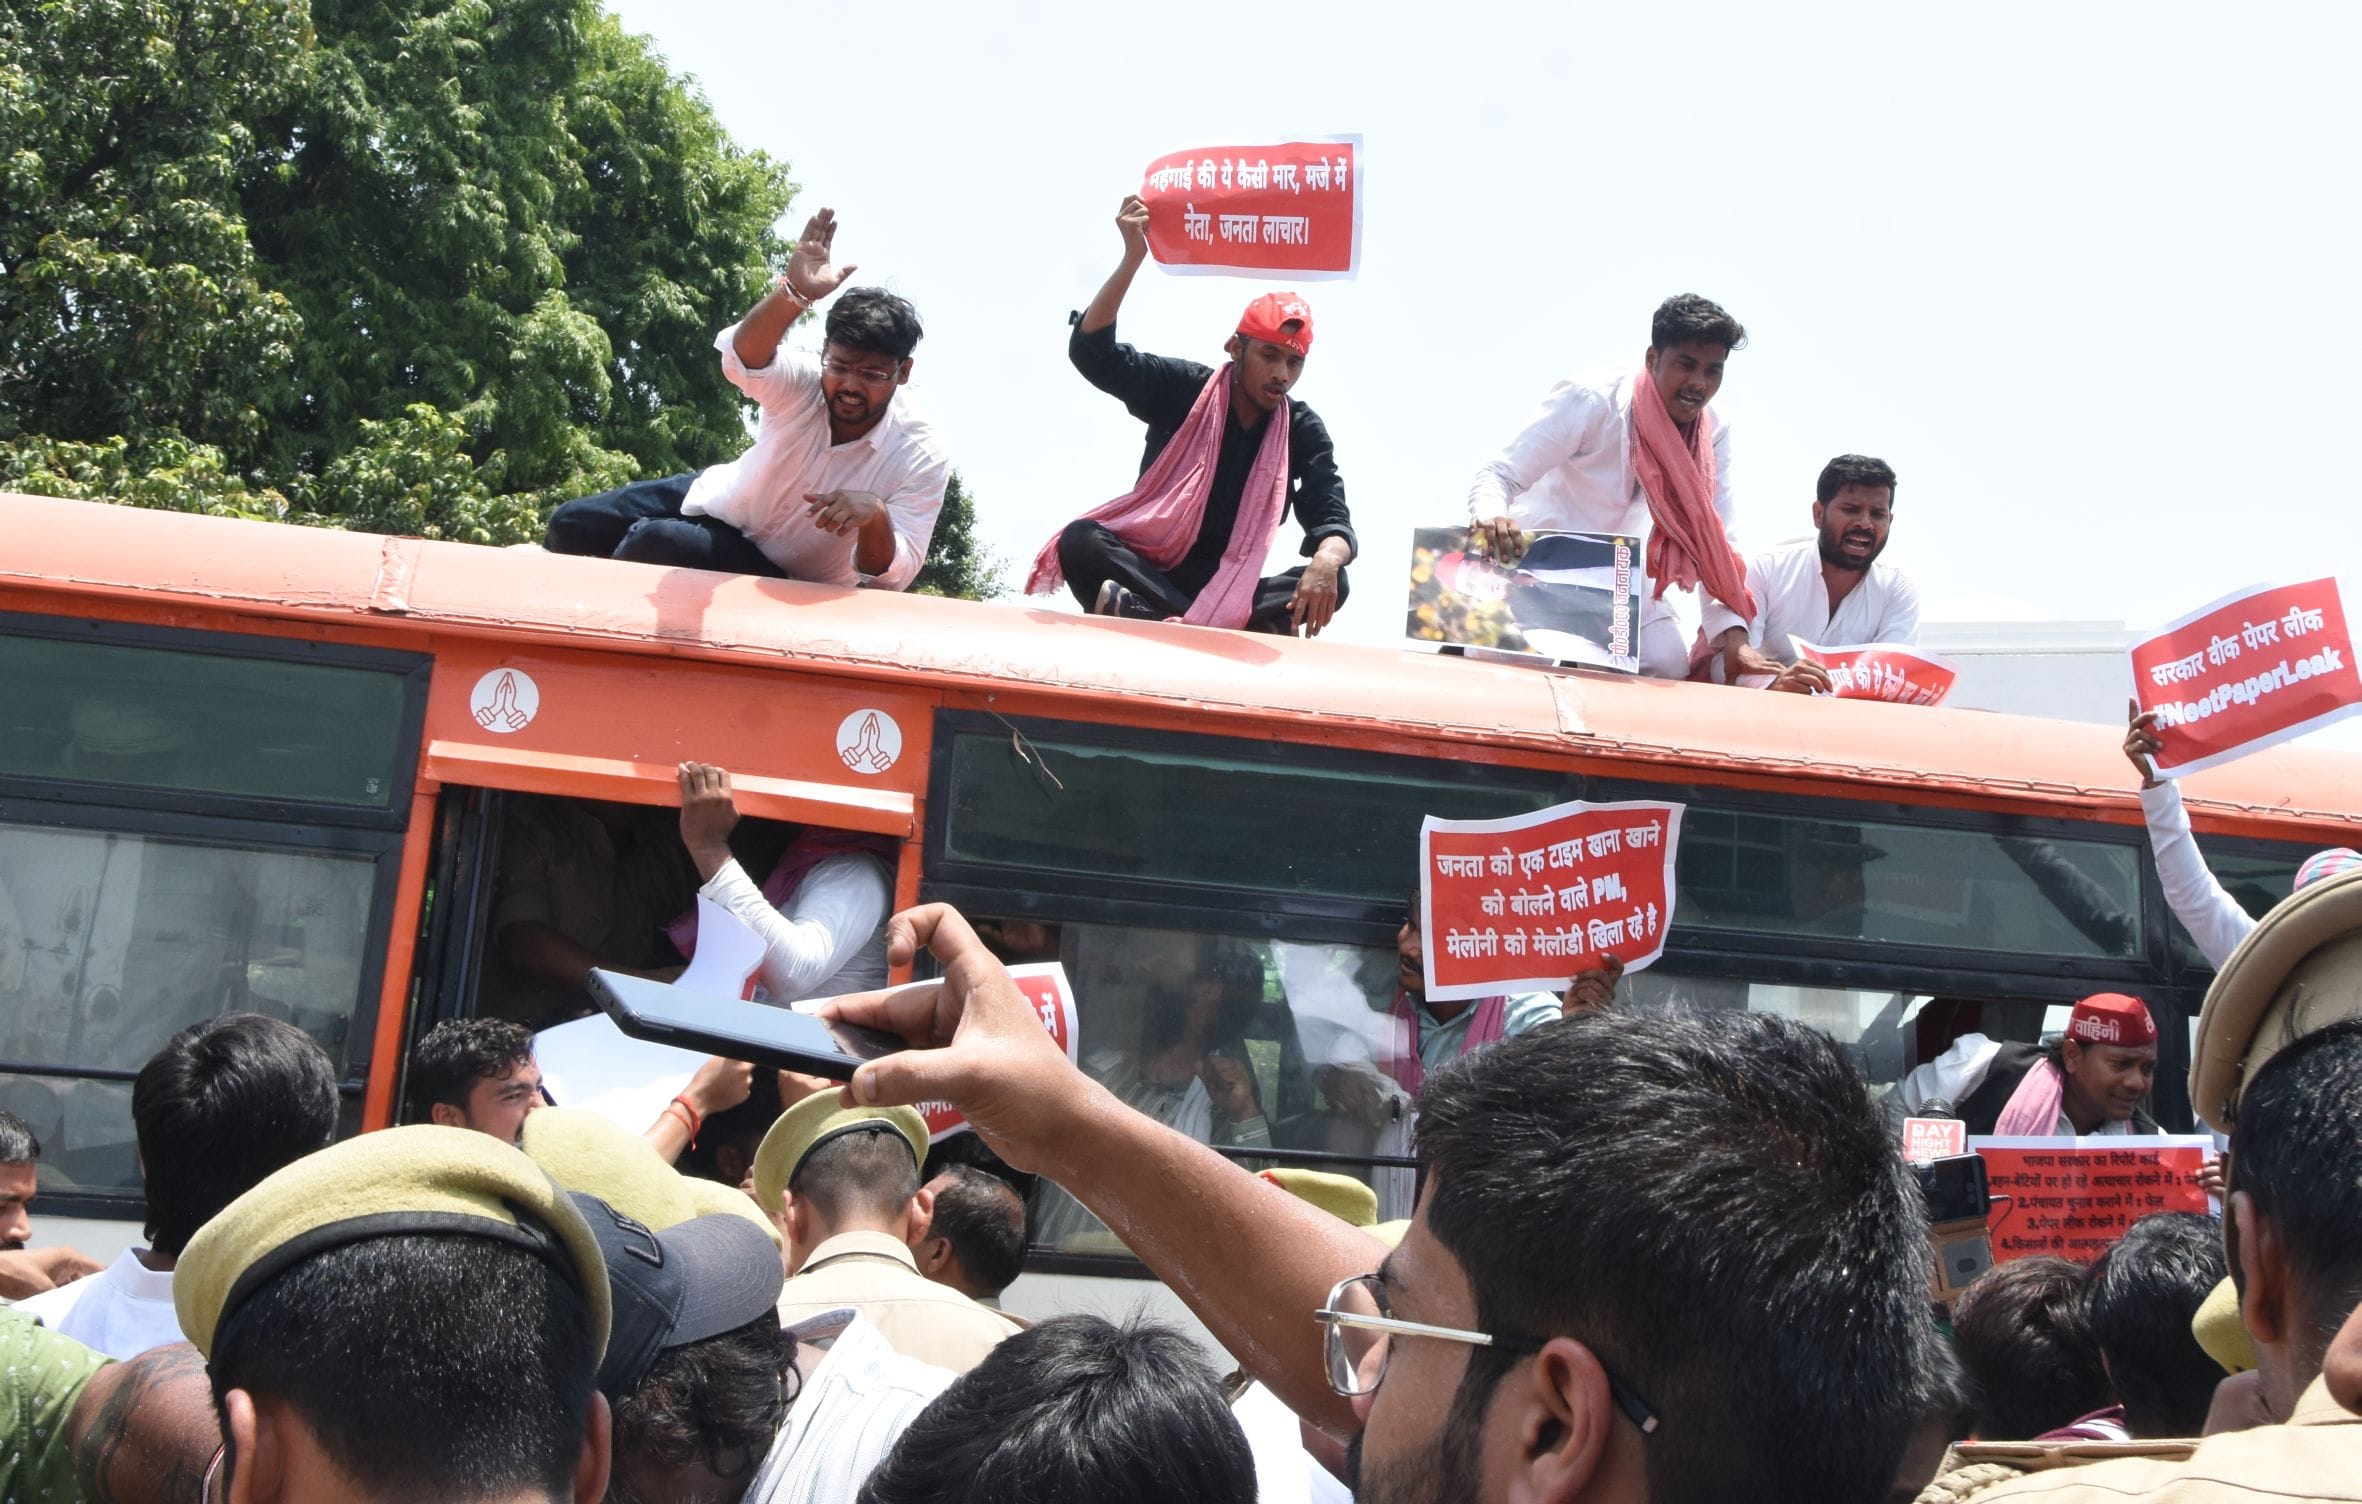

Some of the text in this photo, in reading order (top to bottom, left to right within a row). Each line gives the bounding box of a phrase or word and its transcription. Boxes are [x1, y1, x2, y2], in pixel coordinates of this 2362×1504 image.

[1150, 156, 1347, 195] महंगाई की ये कैसी मार, मजे में
[1184, 202, 1310, 245] नेता, जनता लाचार।
[1614, 545, 1631, 604] जननायक
[2151, 606, 2324, 687] सरकार वीक पेपर लीक
[1853, 660, 1871, 692] की
[2152, 646, 2344, 731] #NeetPaperLeak
[1437, 820, 1661, 880] जनता को एक टाइम खाना खाने
[1481, 872, 1627, 916] को बोलने वाले PM,
[1446, 902, 1657, 959] मेलोनी को मेलोडी खिला रहे है
[2075, 1015, 2120, 1041] वाहिनी
[1911, 1137, 1952, 1149] NIGHT
[1912, 1123, 1954, 1138] DAY
[1910, 1147, 1952, 1158] NEWS
[2022, 1155, 2055, 1167] भाजपा
[2058, 1155, 2090, 1167] सरकार
[2094, 1155, 2107, 1166] का
[2110, 1151, 2136, 1166] रिपोर्ट
[2045, 1176, 2058, 1188] पर
[2061, 1172, 2072, 1189] हो
[2075, 1172, 2088, 1189] रहे
[2092, 1175, 2132, 1187] अत्याचार
[2136, 1171, 2161, 1186] रोकने
[2164, 1171, 2173, 1186] में
[2067, 1197, 2093, 1212] चुनाव
[2095, 1192, 2121, 1207] कराने
[2124, 1192, 2133, 1207] में
[2145, 1192, 2164, 1207] फेल
[2063, 1214, 2085, 1229] लीक
[2089, 1214, 2113, 1229] रोकने
[2117, 1213, 2126, 1227] में
[2051, 1235, 2064, 1249] की
